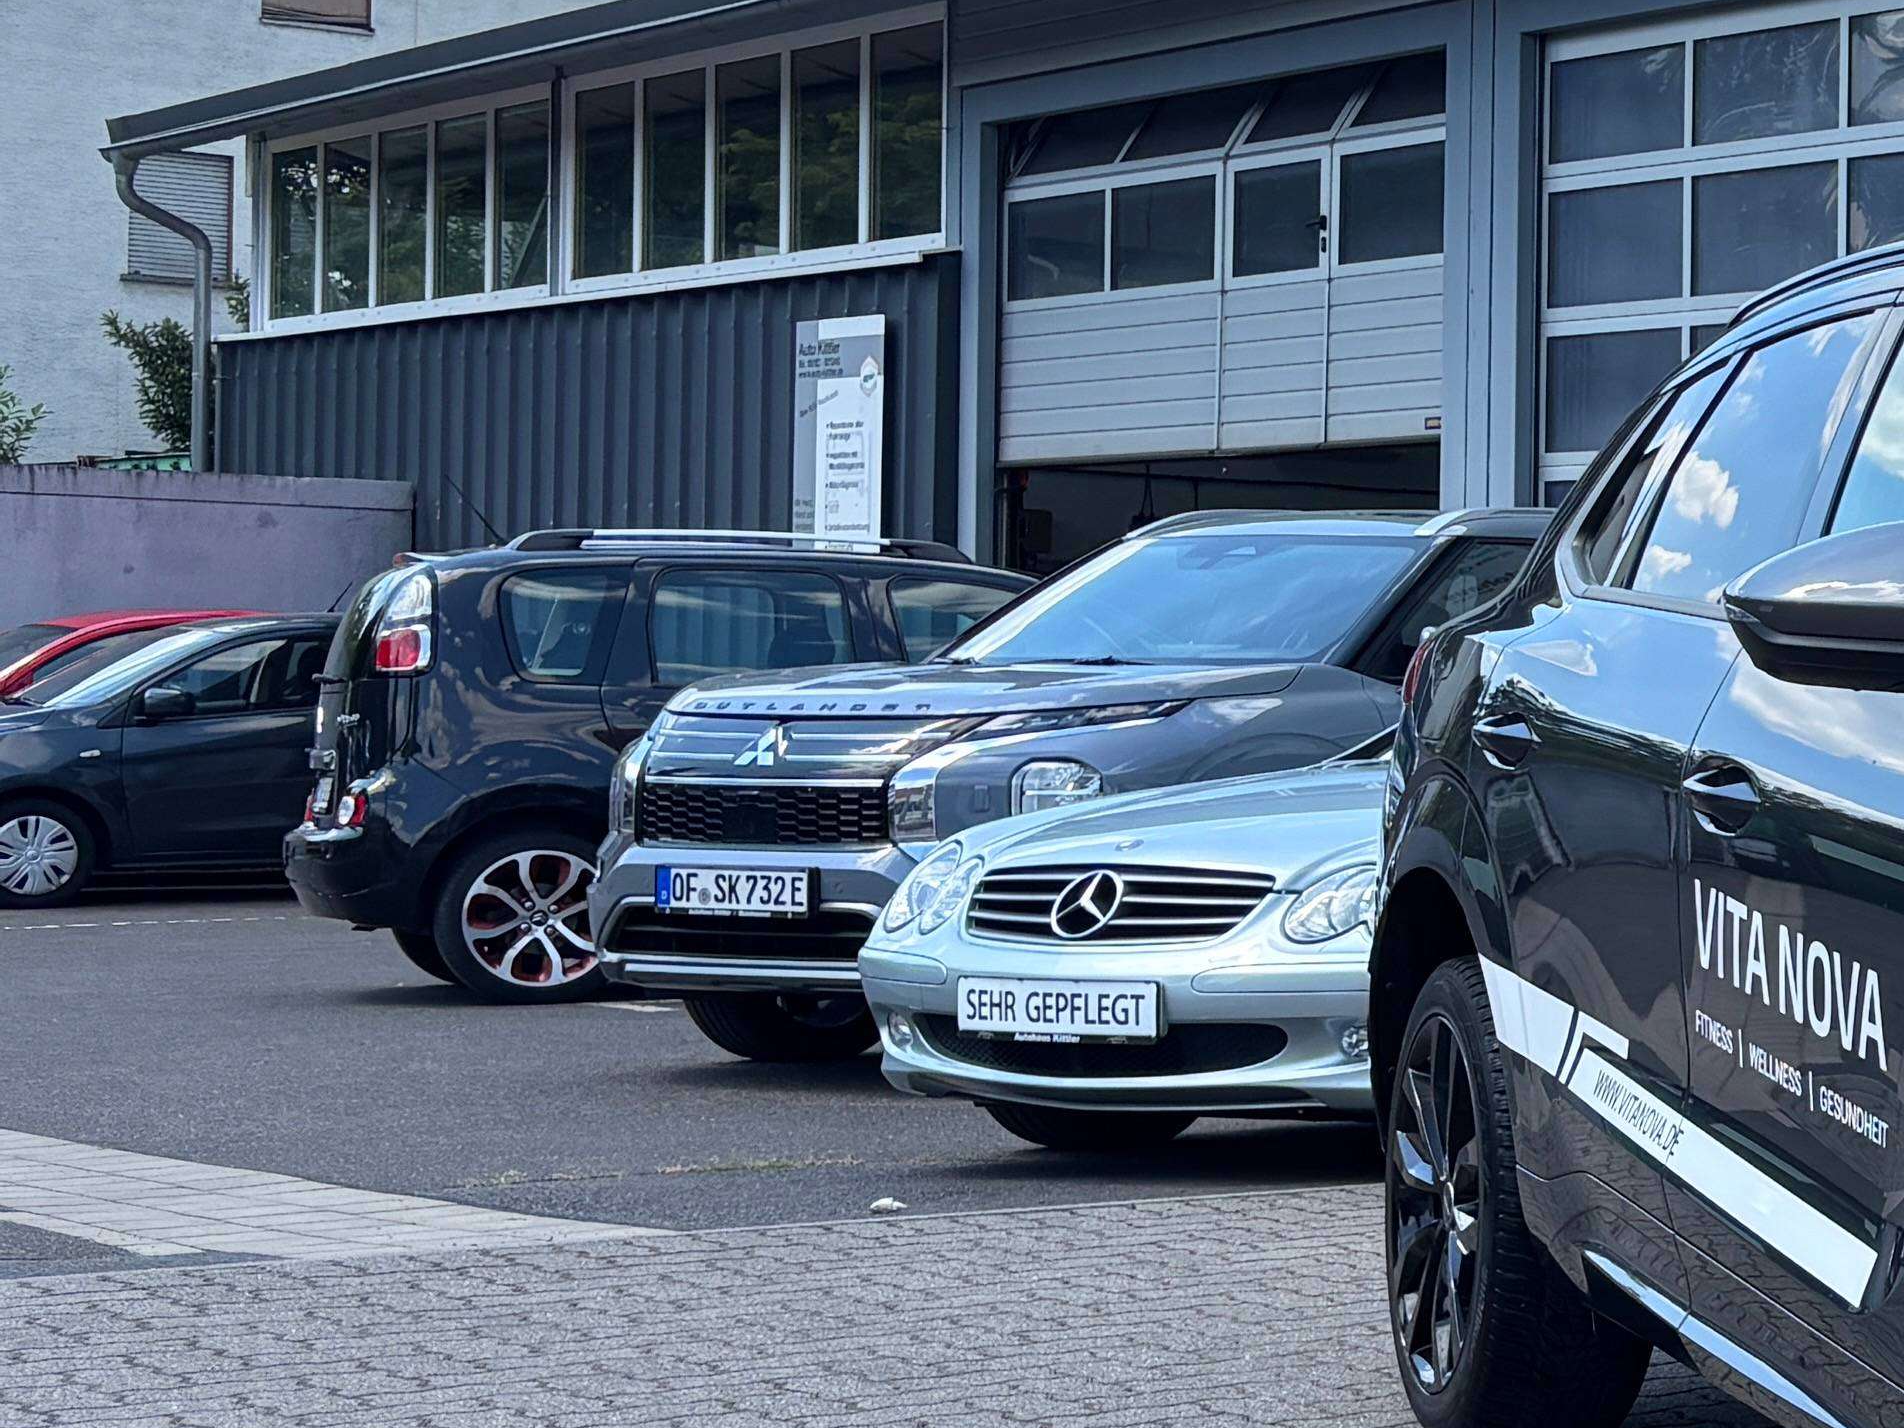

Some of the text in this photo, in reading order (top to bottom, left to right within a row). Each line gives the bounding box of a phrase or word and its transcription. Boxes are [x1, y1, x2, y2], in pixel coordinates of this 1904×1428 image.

[672, 872, 699, 902] OF
[966, 989, 1146, 1026] SEHR GEPFLEGT
[1694, 878, 1888, 1072] VITA NOVA
[1593, 1069, 1685, 1157] WWW.VITANOVA.DE
[1695, 1009, 1889, 1149] FITNESS WELLNESS GESUNDHEIT
